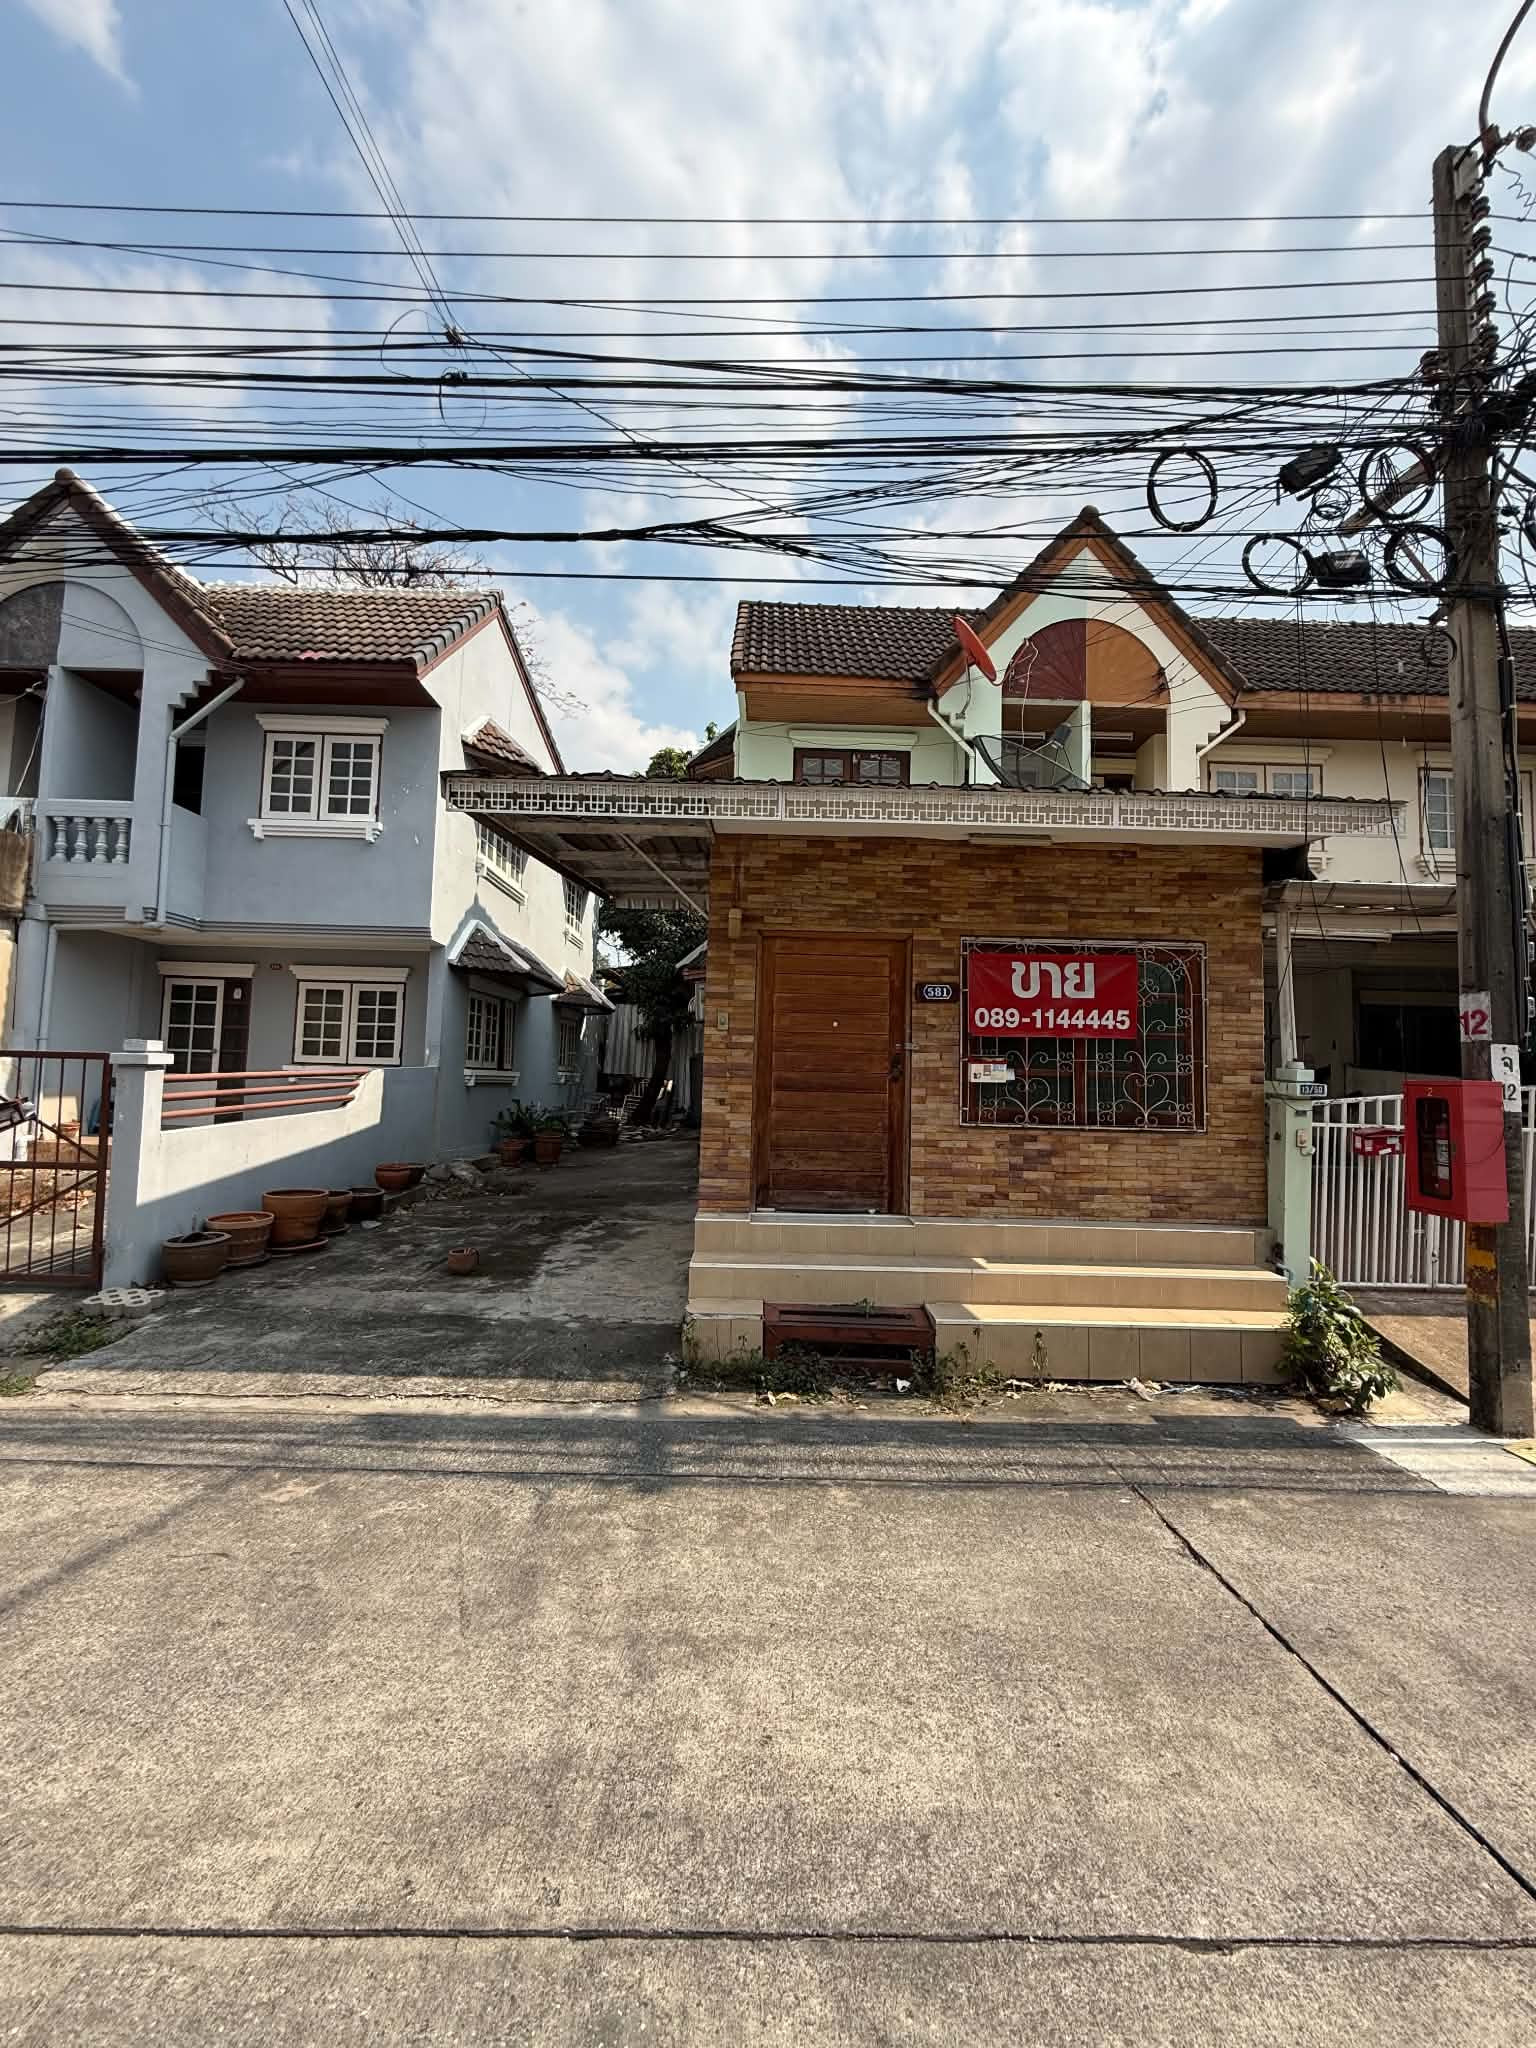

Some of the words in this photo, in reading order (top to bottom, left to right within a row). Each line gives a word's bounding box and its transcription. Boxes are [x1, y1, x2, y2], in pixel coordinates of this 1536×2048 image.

[927, 987, 948, 997] 581
[1011, 961, 1095, 999] ขาย
[974, 1007, 1130, 1030] 089-1144445
[1459, 1008, 1489, 1036] 12
